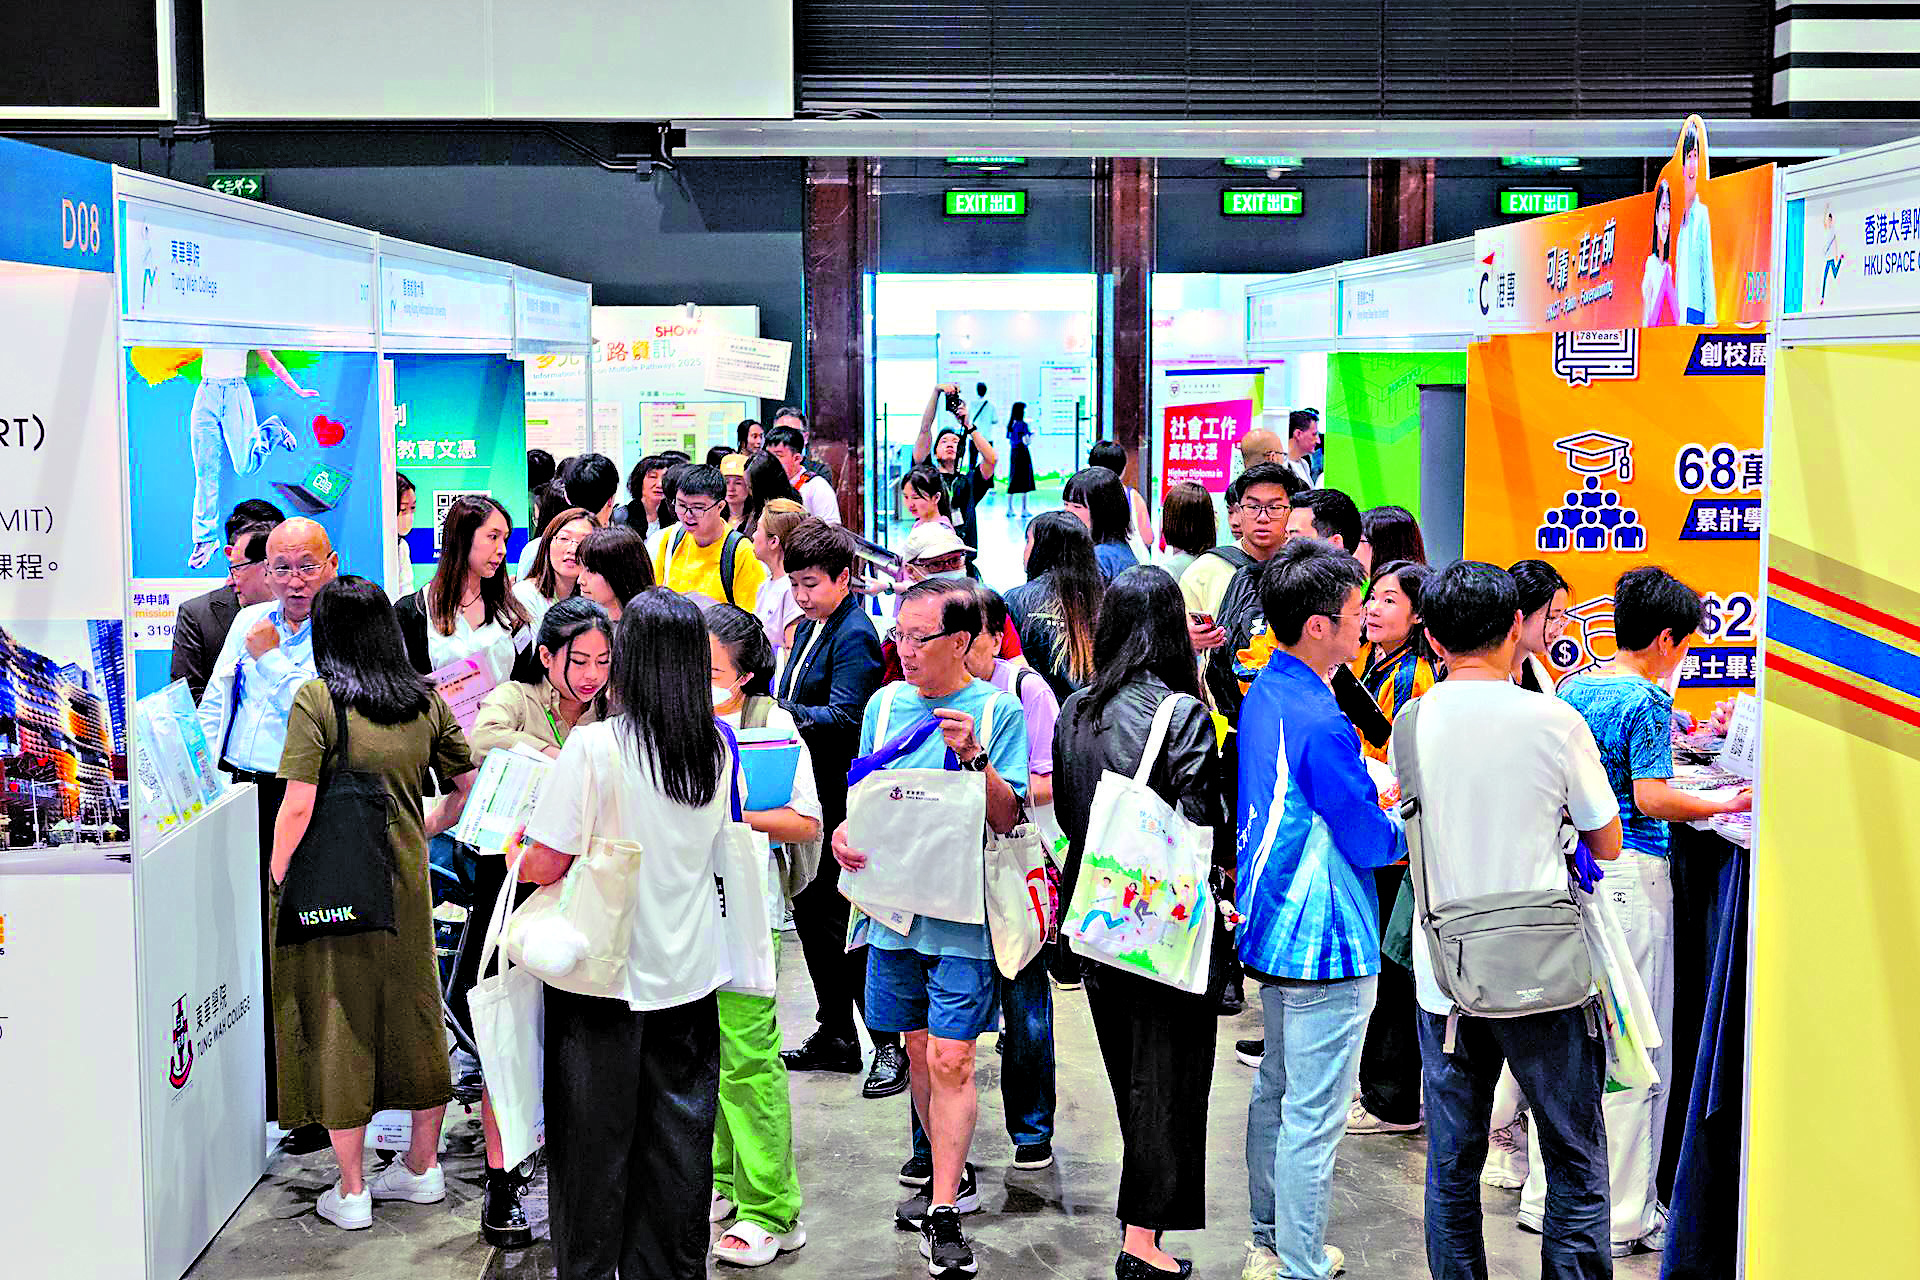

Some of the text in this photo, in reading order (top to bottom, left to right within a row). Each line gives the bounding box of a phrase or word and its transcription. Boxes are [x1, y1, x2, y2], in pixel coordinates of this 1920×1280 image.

[956, 194, 1016, 212] EXIT 出口
[1233, 194, 1294, 212] EXIT 出口
[1510, 194, 1568, 211] EXIT 出口
[62, 198, 100, 254] D08
[1864, 253, 1883, 277] HKU
[1885, 250, 1915, 275] SPACE
[171, 272, 185, 295] Tung
[1170, 416, 1237, 440] 社會工作
[397, 439, 476, 460] 教育文憑
[1696, 508, 1761, 532] 累計學
[133, 594, 170, 606] 學申請
[1681, 654, 1757, 680] 學士畢
[299, 906, 356, 925] HSUHK
